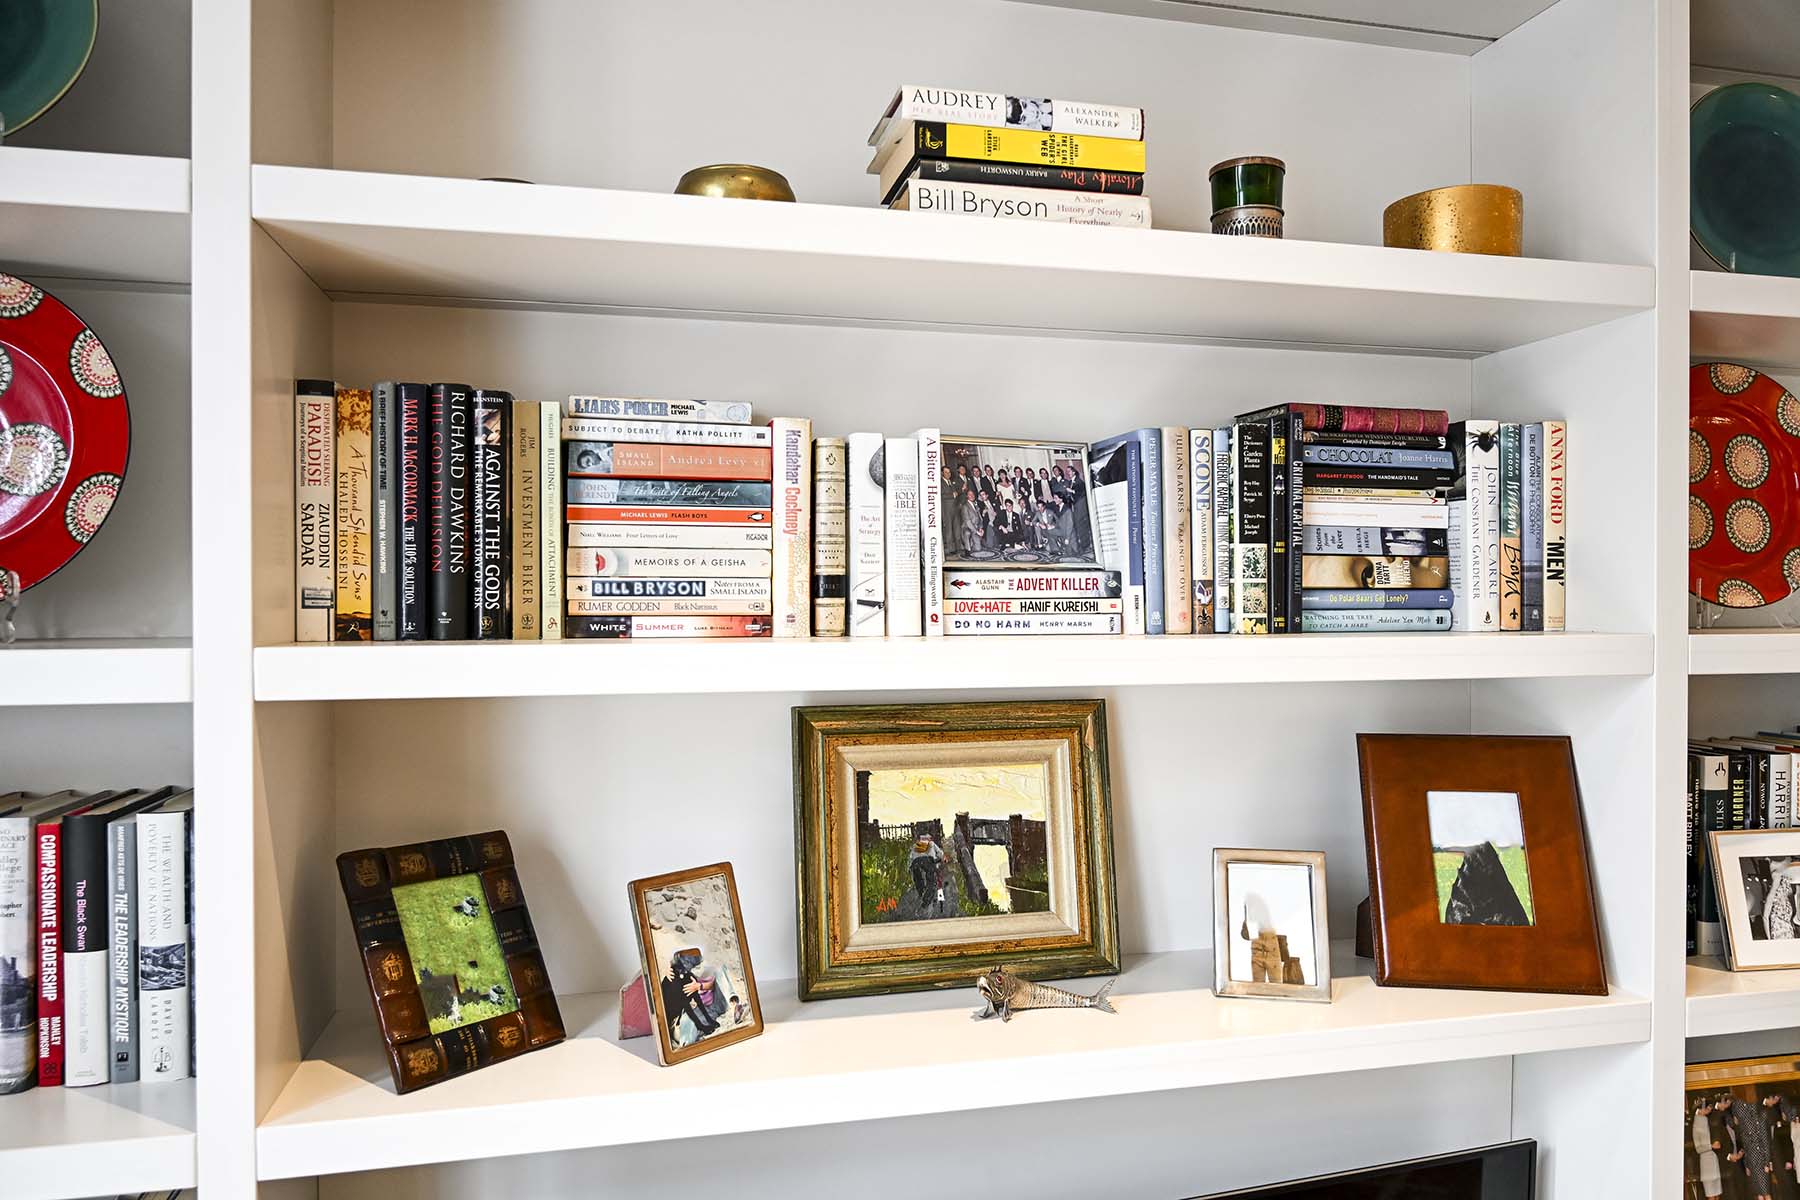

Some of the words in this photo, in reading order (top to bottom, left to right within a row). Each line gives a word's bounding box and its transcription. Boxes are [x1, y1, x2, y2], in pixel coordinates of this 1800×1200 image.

[913, 89, 998, 110] AUDREY
[1065, 106, 1120, 118] ALEXANDER
[1075, 117, 1113, 128] WALKER
[918, 187, 954, 211] Bill
[963, 191, 1048, 218] Bryson
[1058, 205, 1085, 214] History
[1087, 206, 1095, 214] of
[1096, 207, 1122, 217] Nearly
[404, 400, 417, 431] MARK
[431, 392, 442, 427] THE
[574, 398, 620, 415] LIAR'S
[623, 400, 669, 416] POKER
[308, 402, 321, 486] PARADISE
[404, 435, 417, 446] H.
[451, 392, 465, 479] RICHARD
[568, 425, 607, 433] SUBJECT
[627, 427, 660, 435] DEBATE
[927, 437, 937, 447] A
[351, 445, 365, 459] A
[431, 432, 442, 474] GOD
[474, 449, 483, 469] THE
[617, 458, 654, 466] ISLAND
[619, 451, 650, 459] SMALL
[668, 454, 712, 465] Andrea
[718, 455, 746, 468] Levy
[786, 430, 801, 484] Kandahar
[928, 451, 938, 482] Bitter
[1176, 434, 1184, 471] JULIAN
[1319, 449, 1393, 463] CHOCOLAT
[1399, 453, 1423, 461] Joanne
[1425, 454, 1448, 463] Harris
[1507, 426, 1515, 477] Afternoon
[1551, 424, 1564, 473] ANNA
[349, 462, 368, 511] Thousand
[404, 449, 418, 522] McCORMACK
[485, 449, 500, 521] AGAINST
[1195, 436, 1211, 511] SCONE
[1217, 454, 1228, 486] FREDERIC
[1292, 461, 1303, 505] CRIMINAL
[1471, 465, 1480, 484] THE
[339, 471, 348, 523] KHALED
[474, 472, 483, 535] REMARKABLE
[633, 485, 648, 495] The
[650, 486, 668, 498] City
[670, 484, 680, 502] of
[681, 484, 709, 502] Falling
[711, 488, 738, 502] Angels
[1150, 471, 1158, 506] MAYLE
[1217, 487, 1228, 518] RAPHAEL
[1551, 476, 1563, 524] FORD
[522, 470, 533, 558] INVESTMENT
[783, 487, 801, 535] Cockney
[928, 486, 938, 528] Harvest
[1471, 487, 1480, 539] CONSTANT
[1506, 480, 1520, 534] William
[301, 503, 314, 567] SARDAR
[319, 503, 330, 568] ZIAUDDIN
[348, 514, 366, 566] Splendid
[405, 526, 415, 542] THE
[431, 481, 442, 572] DELUSION
[450, 488, 465, 573] DAWKINS
[485, 525, 500, 560] THE
[1292, 508, 1303, 546] CAPITAL
[339, 529, 348, 590] HOSSEINI
[405, 544, 416, 564] 110%
[474, 537, 483, 571] STORY
[634, 558, 679, 566] MEMOIRS
[1471, 545, 1481, 599] GARDENER
[1501, 544, 1520, 599] Boyd
[352, 570, 367, 600] Suns
[405, 566, 415, 604] SOLUTION
[474, 573, 483, 585] OF
[485, 565, 500, 609] GODS
[522, 565, 532, 604] BIKER
[593, 582, 629, 595] BILL
[633, 582, 704, 596] BRYSON
[1017, 578, 1058, 591] ADVENT
[1062, 578, 1099, 590] KILLER
[474, 587, 483, 609] RISK
[578, 602, 612, 611] RUMER
[616, 602, 660, 611] GODDEN
[955, 601, 1012, 613] LOVE+HATE
[1020, 601, 1050, 612] HANIF
[1054, 601, 1099, 612] KUREISHI
[955, 620, 970, 628] DO
[976, 620, 990, 628] NO
[996, 620, 1031, 628] HARM
[1733, 779, 1744, 823] GARDNER
[1775, 771, 1786, 830] HARRIS
[148, 824, 157, 871] POVERTY
[40, 834, 57, 928] COMPASSIONATE
[76, 880, 86, 897] The
[149, 878, 157, 890] OF
[76, 899, 86, 923] Black
[115, 893, 128, 914] THE
[149, 894, 158, 940] NATIONS
[77, 925, 87, 951] Swan
[115, 917, 128, 984] LEADERSHIP
[41, 932, 57, 1001] LEADERSHIP
[51, 1016, 61, 1045] MANLEY
[115, 987, 129, 1042] MYSTIQUE
[151, 996, 159, 1040] LANDES
[39, 1017, 50, 1058] HOPKINSON
